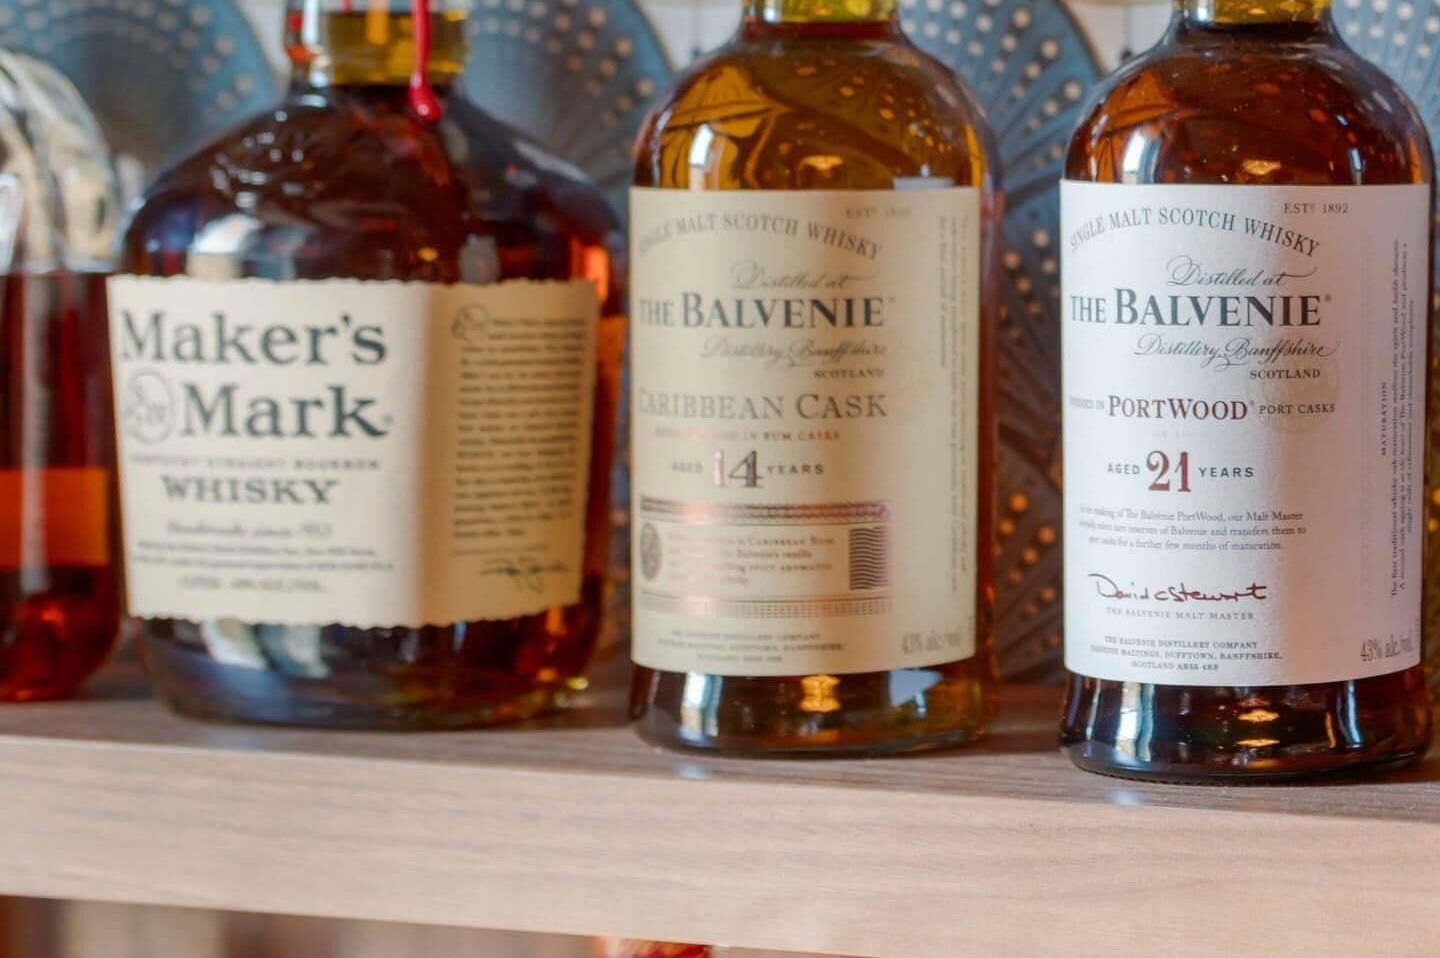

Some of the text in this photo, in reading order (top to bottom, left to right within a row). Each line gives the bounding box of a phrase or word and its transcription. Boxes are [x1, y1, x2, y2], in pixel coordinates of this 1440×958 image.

[1322, 203, 1349, 214] 1892
[675, 212, 718, 234] MALT
[721, 212, 799, 237] SCOTCH
[807, 221, 882, 262] WHISKY
[1109, 207, 1152, 230] MALT
[1158, 207, 1236, 231] SCOTCH
[1244, 217, 1320, 258] WHISKY
[1166, 255, 1318, 287] Distilled at
[639, 290, 884, 329] THE BALVENIE
[1070, 288, 1321, 327] THE BALVENIE
[120, 309, 388, 366] Maker's
[1221, 337, 1338, 370] Banffshire
[814, 368, 884, 379] SCOTLAND
[1250, 368, 1320, 380] SCOTLAND
[180, 382, 388, 438] Mark
[796, 393, 888, 419] CASK
[1259, 404, 1294, 415] PORT
[1297, 403, 1336, 414] CASKS
[712, 449, 765, 488] 14
[767, 464, 825, 475] YEARS
[1107, 450, 1255, 492] AGED 21 YEARS
[161, 475, 339, 504] WHISKY
[1177, 511, 1225, 522] PortWood,
[1228, 513, 1244, 522] our
[1246, 511, 1269, 522] Malt
[1272, 511, 1303, 522] Master
[1088, 573, 1267, 602] David Stewart
[1176, 612, 1205, 620] MALT
[1209, 613, 1254, 621] MASTER
[1212, 641, 1258, 649] COMPANY
